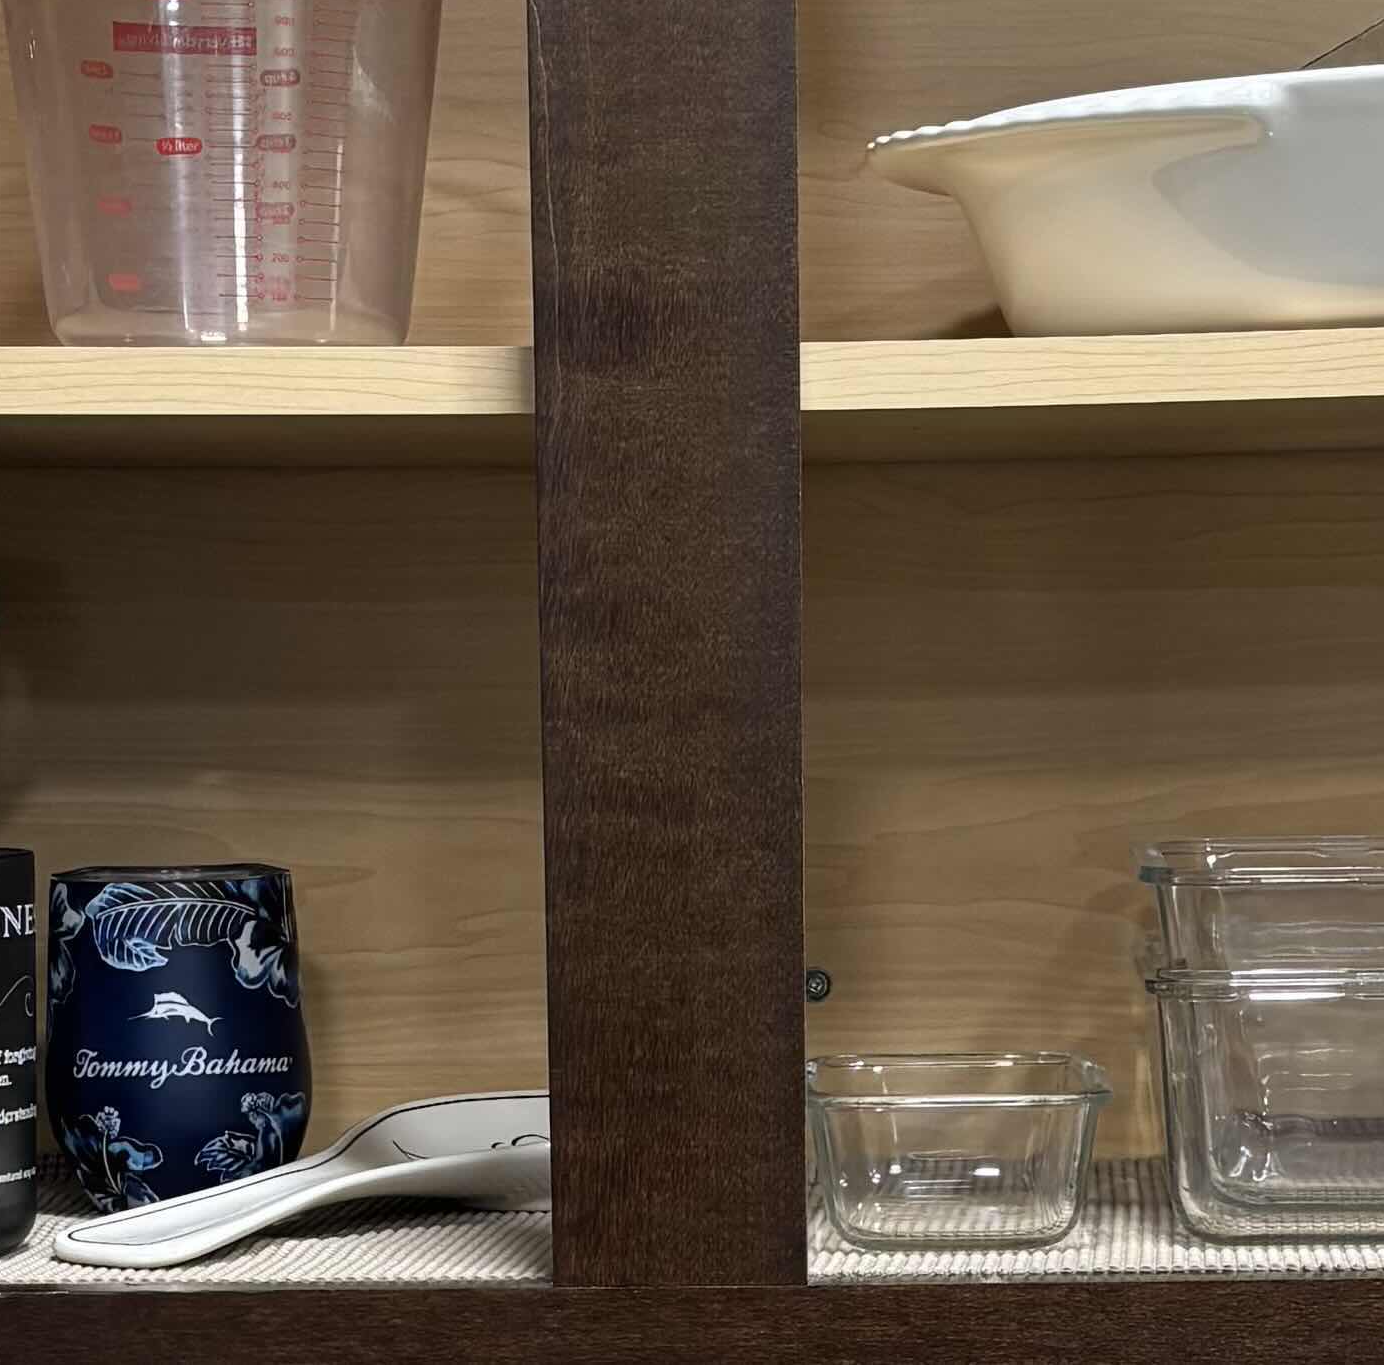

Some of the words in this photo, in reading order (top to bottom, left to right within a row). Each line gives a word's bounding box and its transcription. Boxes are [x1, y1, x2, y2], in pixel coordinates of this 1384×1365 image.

[175, 138, 200, 153] liter
[73, 1049, 169, 1089] Tommy
[170, 1046, 289, 1077] Bahama
